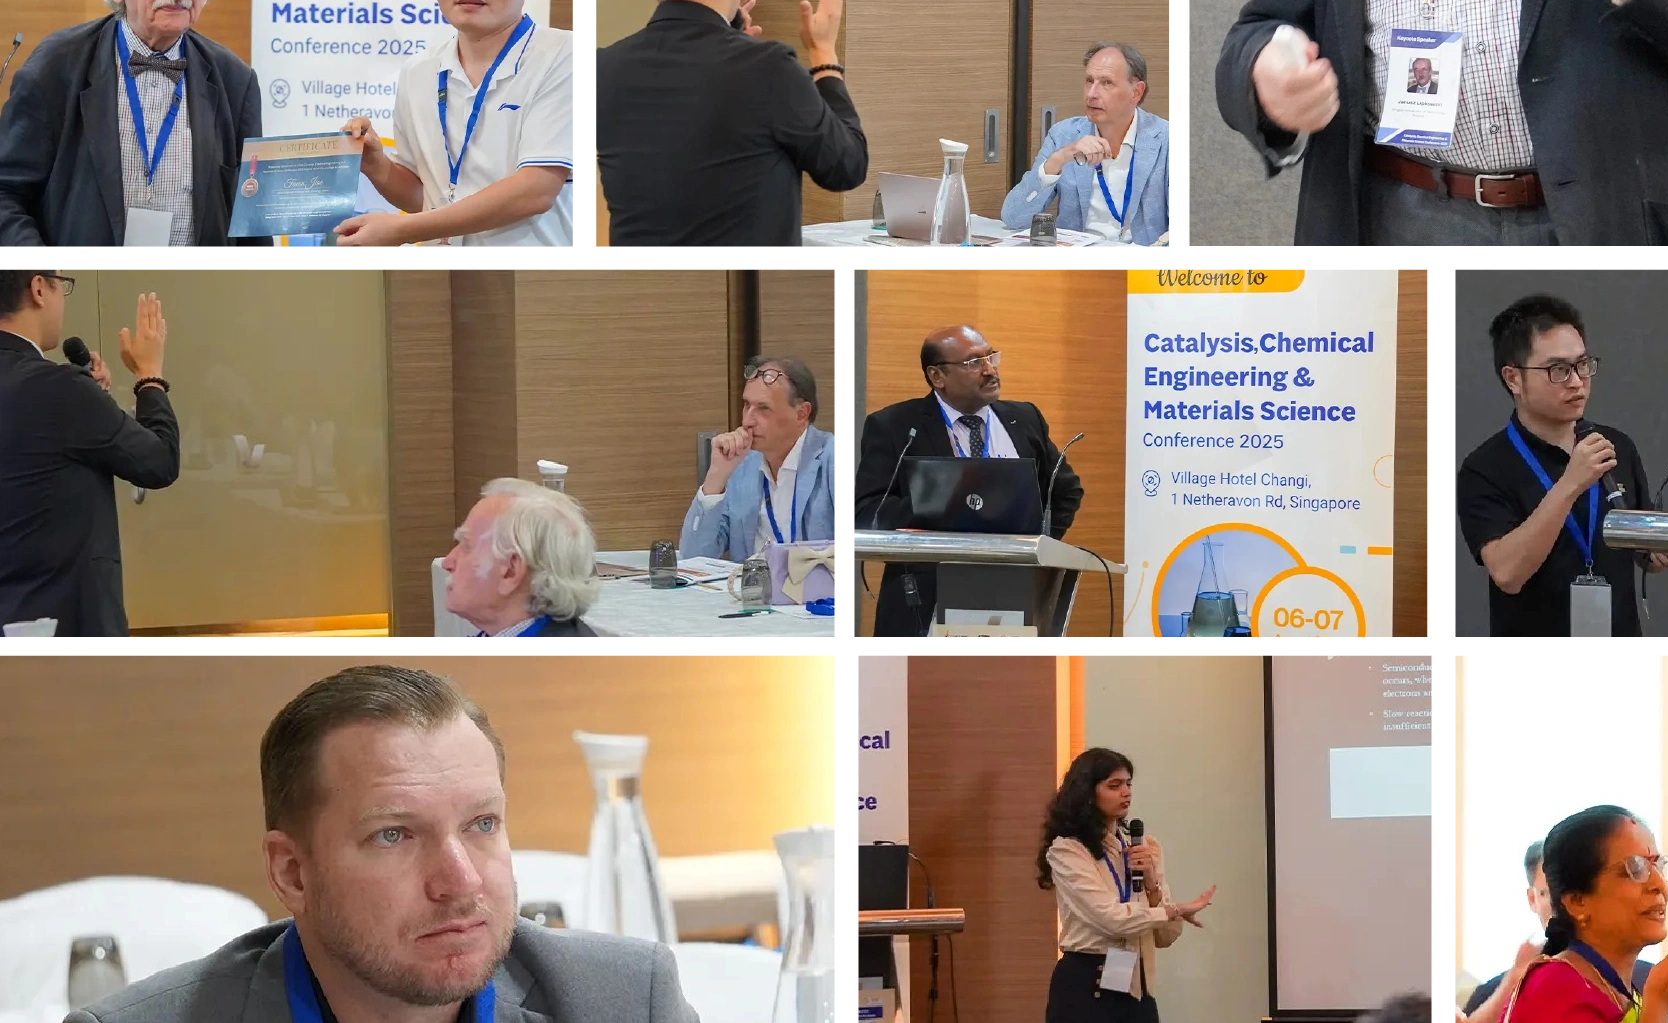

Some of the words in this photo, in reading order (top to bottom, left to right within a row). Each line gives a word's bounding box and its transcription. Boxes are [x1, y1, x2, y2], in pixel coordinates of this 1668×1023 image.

[272, 2, 393, 24] Materials
[270, 37, 372, 55] Conference
[302, 80, 351, 98] Village
[356, 81, 396, 96] Hotel
[302, 104, 308, 117] 1
[1158, 268, 1243, 287] Welcome
[1248, 270, 1267, 286] to
[1259, 331, 1374, 353] Chemical
[1144, 366, 1289, 392] Engineering
[1293, 367, 1315, 387] &
[1144, 400, 1254, 420] Materials
[1260, 400, 1356, 422] Science
[1143, 432, 1234, 448] Conference
[1240, 434, 1283, 449] 2025
[1171, 471, 1216, 488] Village
[1220, 472, 1256, 485] Hotel
[1261, 473, 1311, 490] Changi,
[1171, 493, 1177, 505] 1
[1183, 493, 1260, 507] Netheravon
[1265, 495, 1286, 510] Rd,
[1290, 495, 1360, 512] Singapore
[1273, 607, 1344, 630] 06-07
